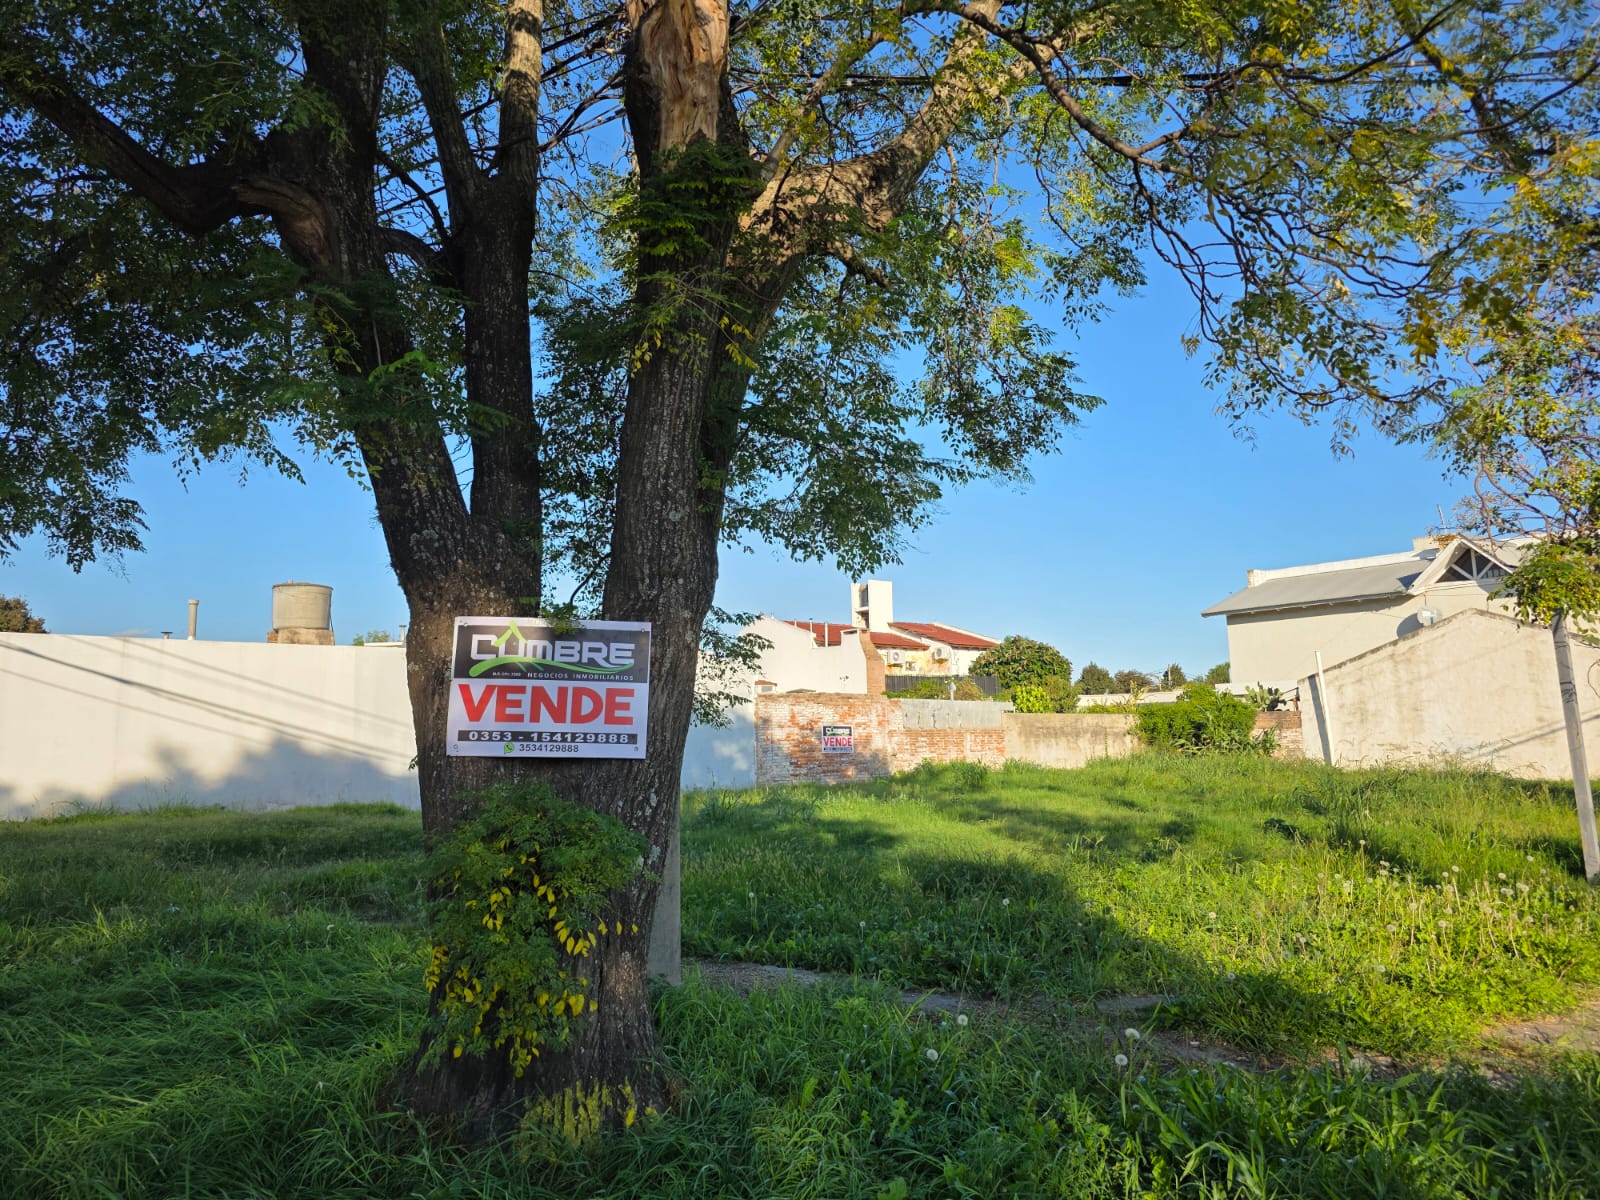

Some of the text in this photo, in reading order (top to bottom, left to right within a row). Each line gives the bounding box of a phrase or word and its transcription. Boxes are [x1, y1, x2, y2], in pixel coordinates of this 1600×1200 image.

[573, 673, 634, 681] INMOBILIARIOS
[458, 684, 635, 725] VENDE
[468, 731, 512, 741] 0353
[530, 733, 629, 743] 154129888
[823, 737, 852, 747] VENDE
[519, 743, 579, 753] 3534129888
